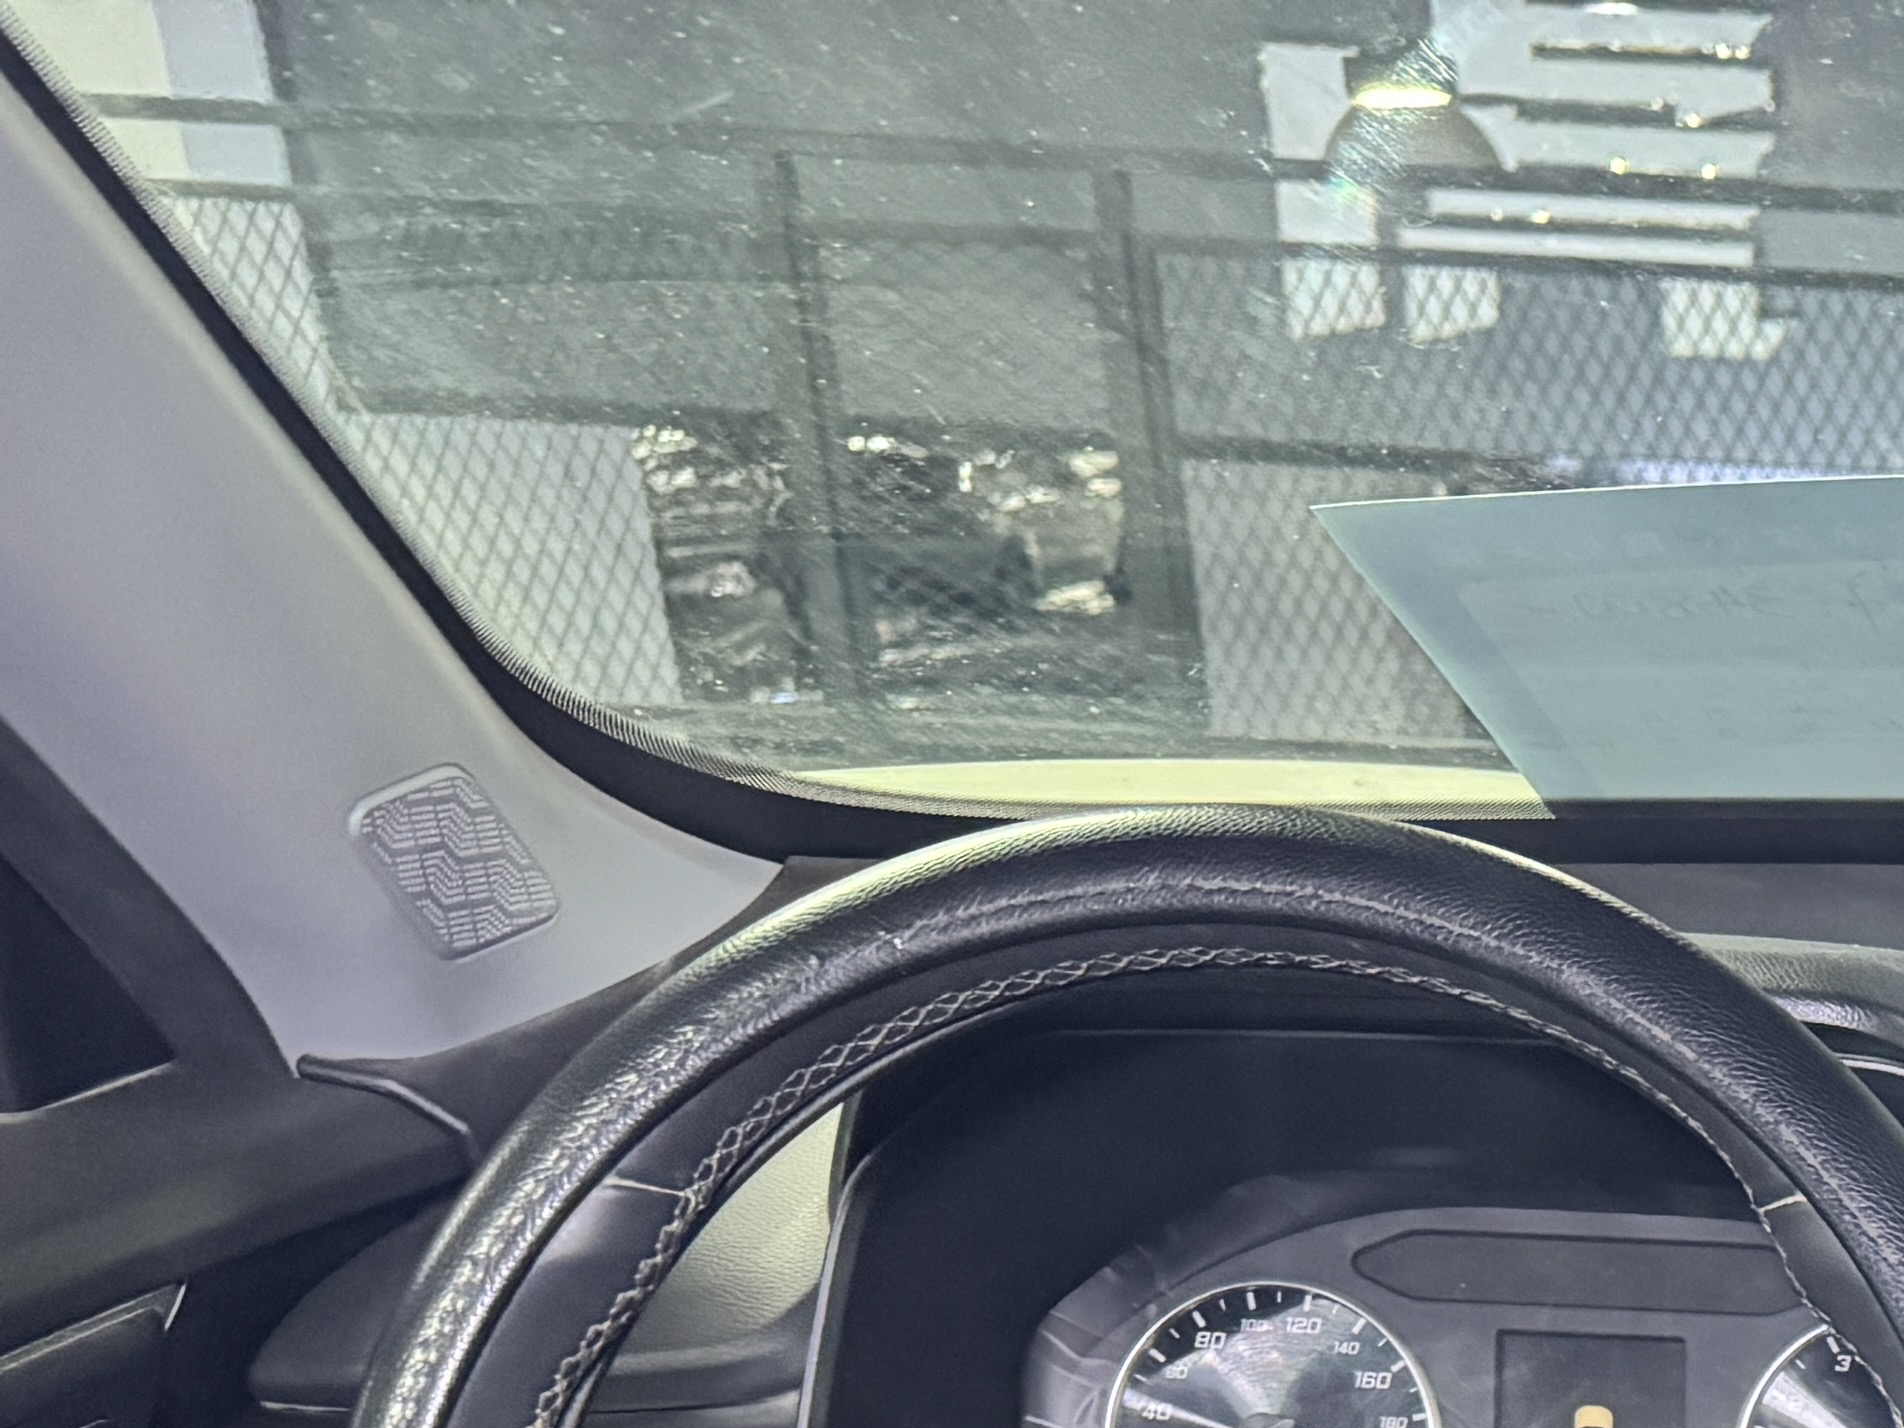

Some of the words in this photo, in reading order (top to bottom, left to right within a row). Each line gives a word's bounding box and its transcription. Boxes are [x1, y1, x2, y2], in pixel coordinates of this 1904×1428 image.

[1286, 1318, 1322, 1334] 120
[1195, 1332, 1226, 1350] 80
[1334, 1342, 1360, 1355] 140
[1834, 1355, 1851, 1372] 3
[1165, 1366, 1188, 1379] 60
[1355, 1372, 1392, 1389] 160
[1142, 1406, 1172, 1421] 40
